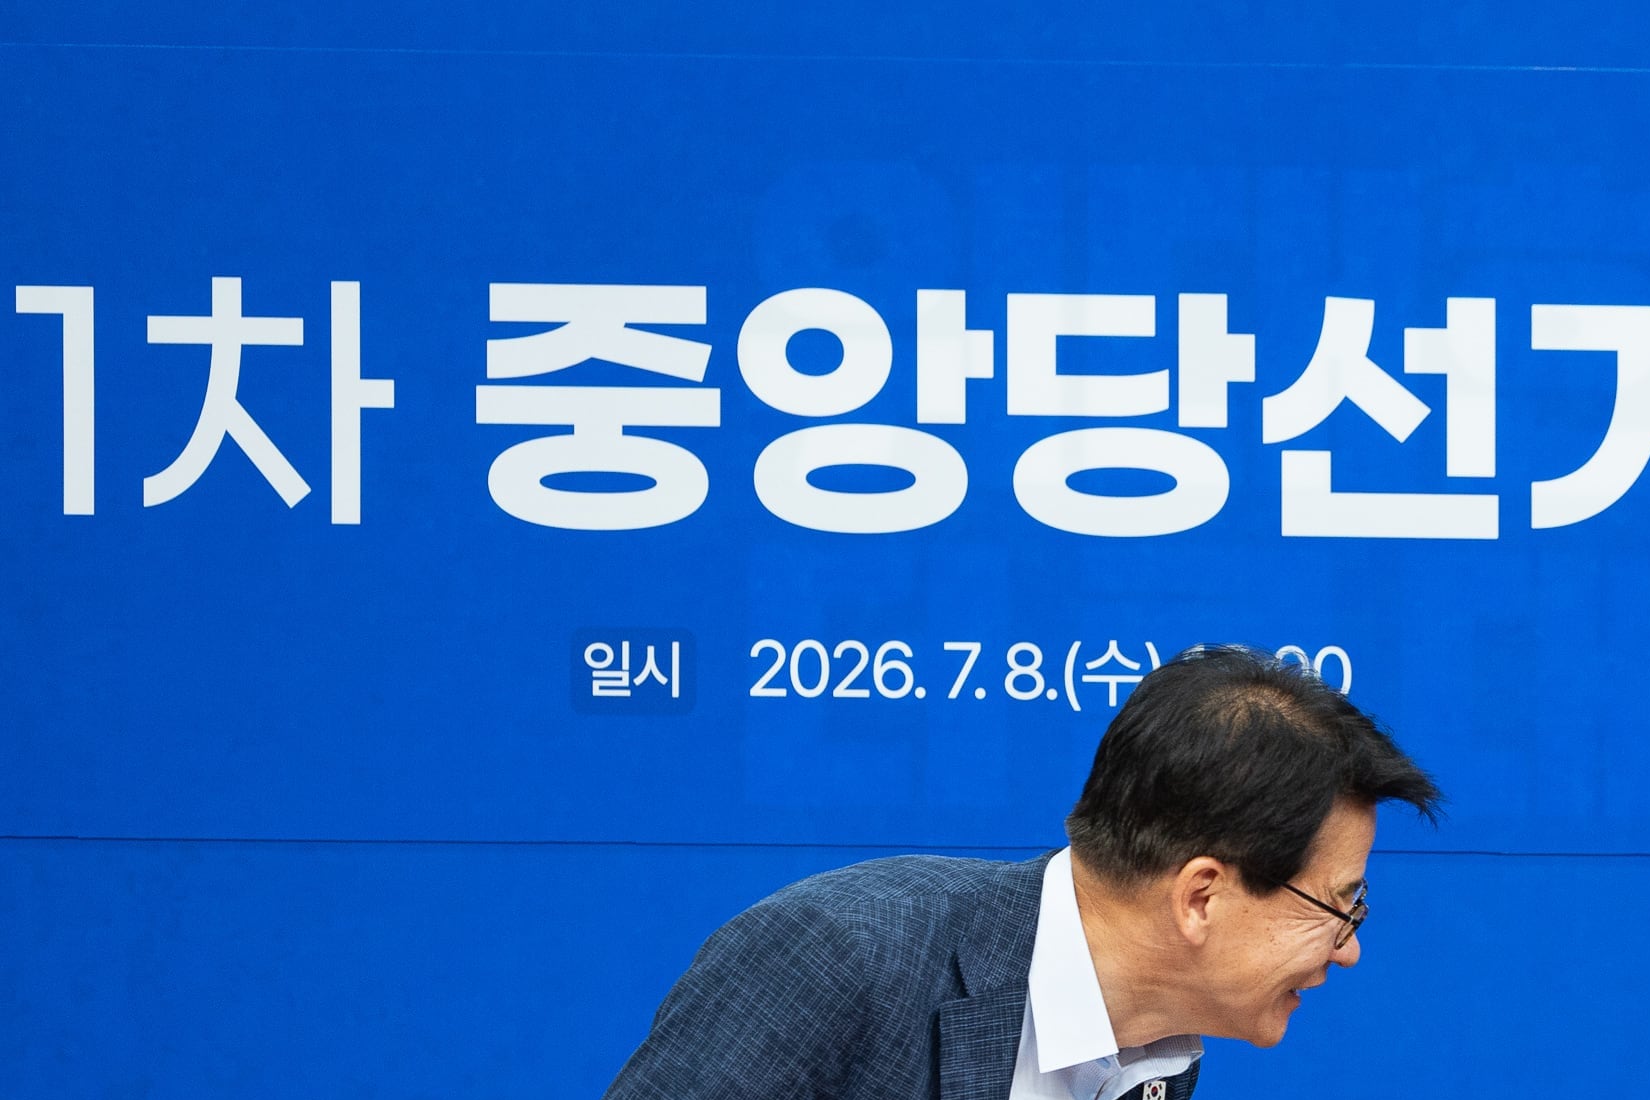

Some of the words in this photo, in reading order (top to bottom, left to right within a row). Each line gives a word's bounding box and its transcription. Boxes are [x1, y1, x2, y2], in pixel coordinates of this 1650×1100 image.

[16, 277, 394, 524] 1차
[584, 641, 679, 697] 일시
[750, 639, 926, 698] 2026.
[944, 642, 986, 699] 7.
